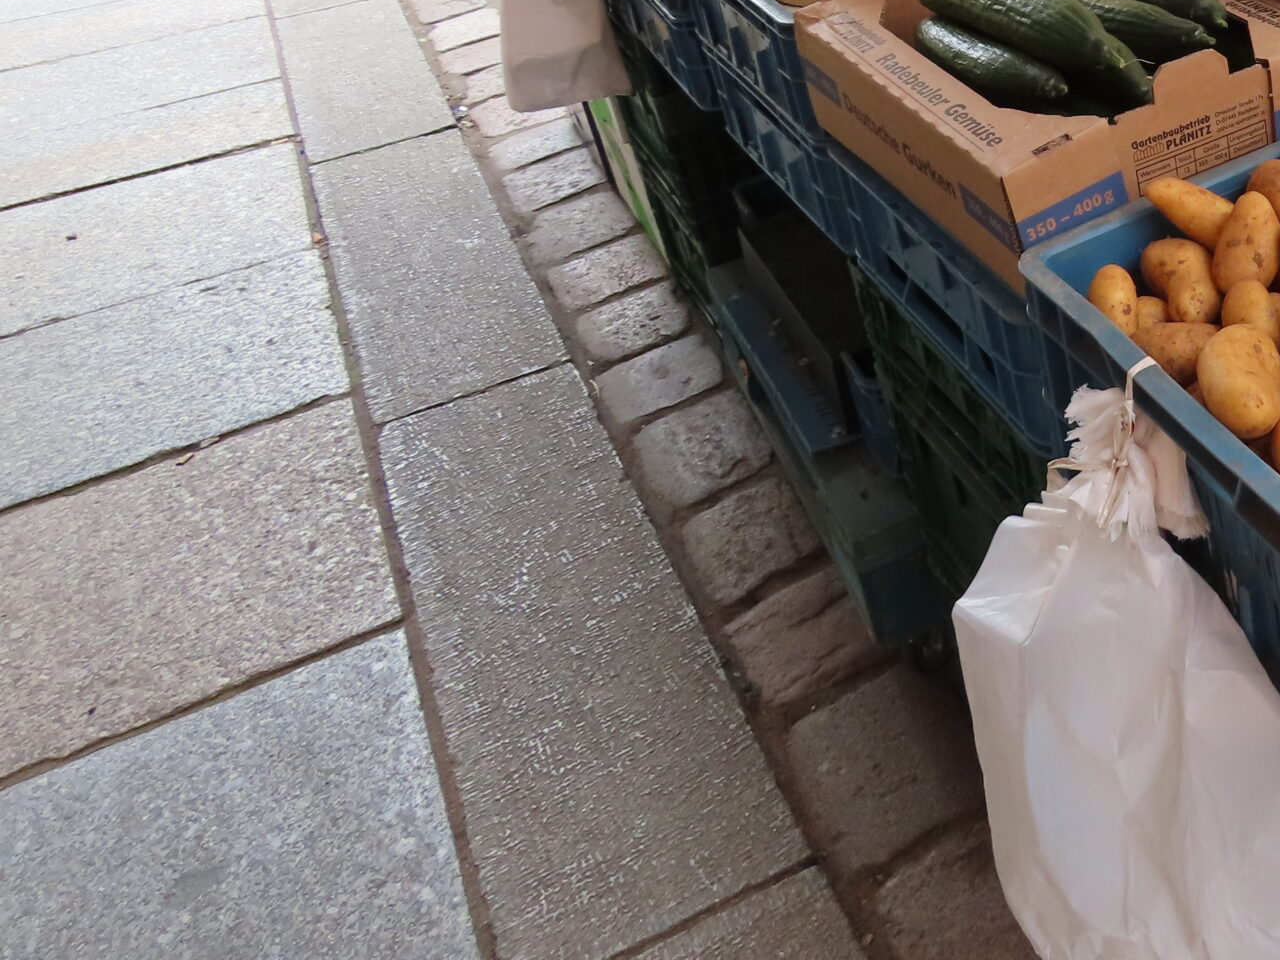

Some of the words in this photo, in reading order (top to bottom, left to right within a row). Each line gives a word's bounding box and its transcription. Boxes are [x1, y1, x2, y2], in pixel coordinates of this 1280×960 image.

[876, 52, 950, 108] Radebeuler
[945, 103, 1004, 148] Gemüse
[843, 92, 901, 154] Deutsche
[901, 142, 957, 199] Gurken
[1131, 114, 1211, 150] Gartenbaubetrieb
[1165, 123, 1213, 150] PLÄNITZ
[1026, 217, 1057, 242] 350
